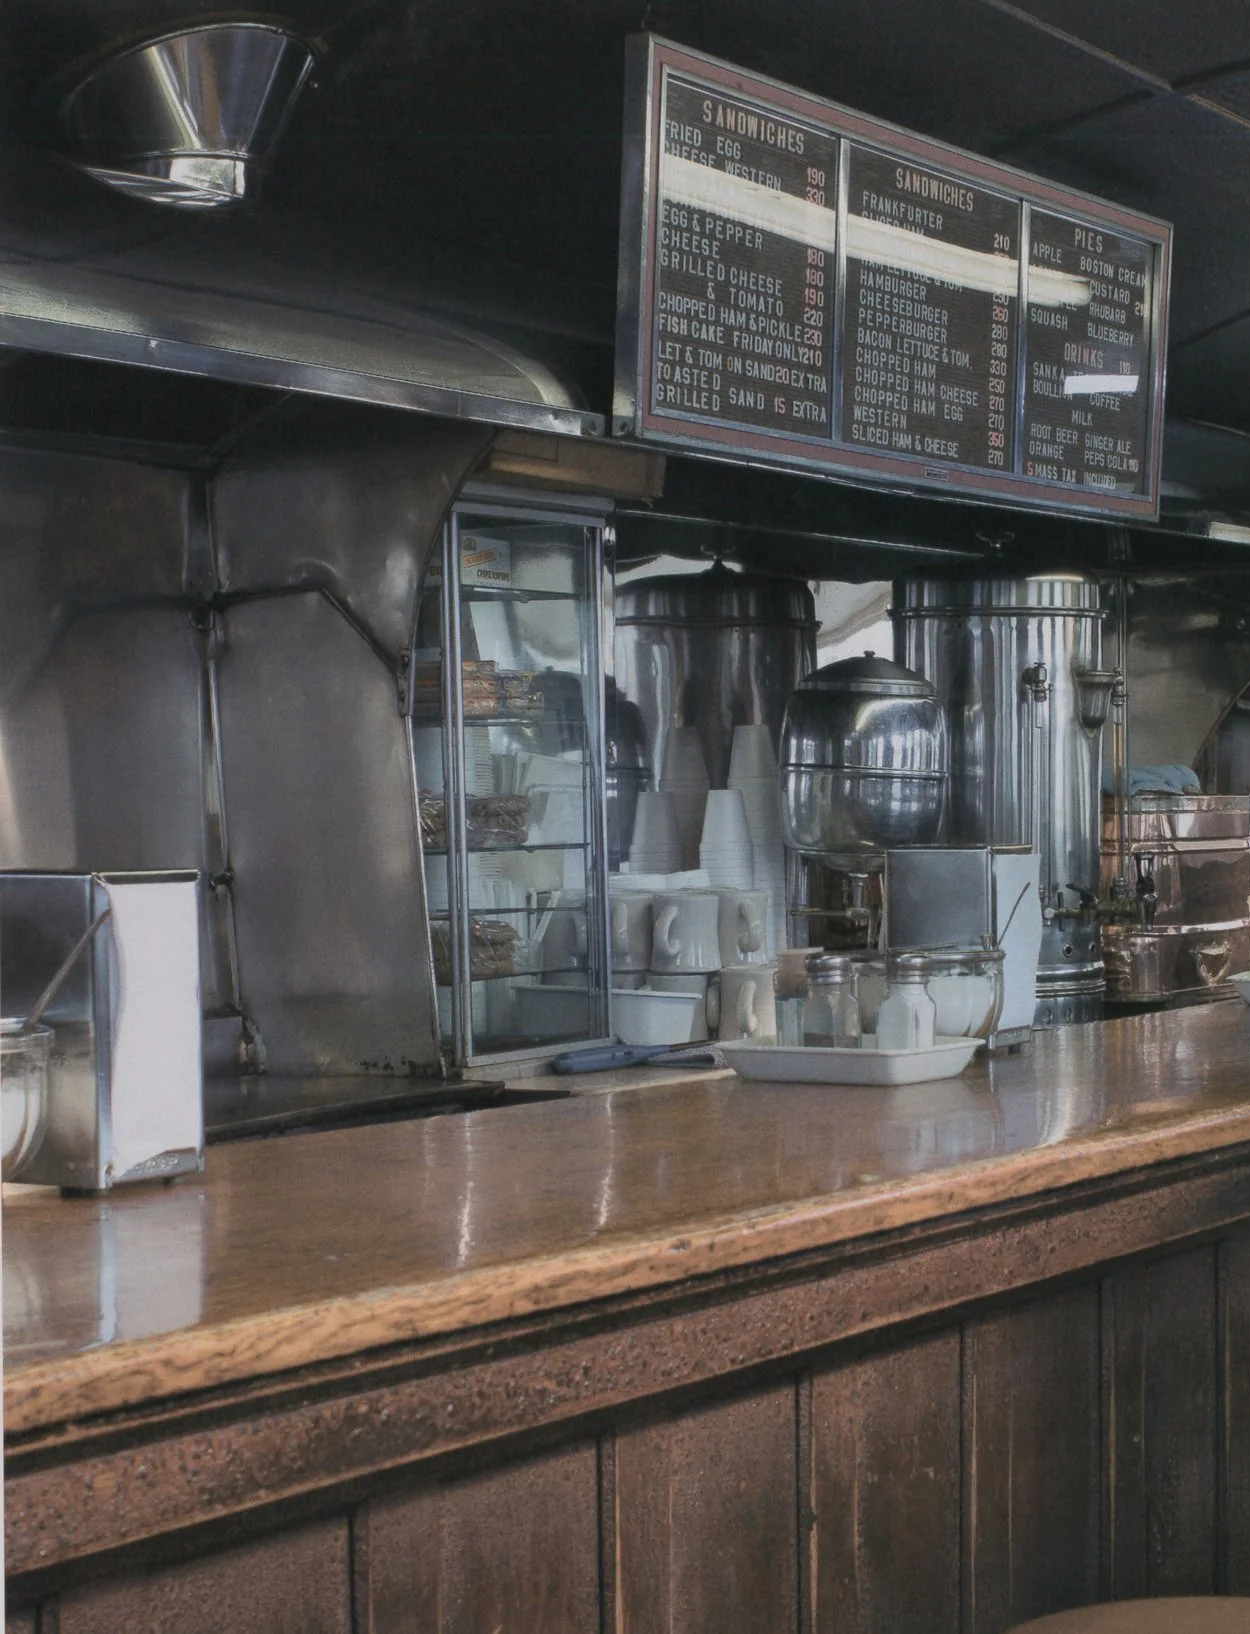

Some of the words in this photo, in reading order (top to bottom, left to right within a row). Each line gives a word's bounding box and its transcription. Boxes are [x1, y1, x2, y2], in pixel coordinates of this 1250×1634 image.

[702, 100, 805, 155] SANDWICHES
[664, 119, 702, 147] FRIED
[716, 136, 741, 160] EGG
[806, 167, 825, 187] 190
[725, 159, 781, 191] WESTERN
[895, 168, 974, 212] SANDWICHES
[662, 205, 688, 230] EGG
[692, 215, 701, 233] &
[705, 217, 763, 249] PEPPER
[806, 247, 825, 267] 180
[862, 191, 943, 231] FRANKFURTER
[993, 233, 1010, 250] 210
[661, 227, 721, 259] CHEESE
[805, 268, 824, 287] 180
[1033, 242, 1062, 264] APPLE
[1074, 228, 1103, 254] PIES
[660, 249, 725, 281] GRILLED
[729, 267, 783, 297] CHEESE
[804, 288, 824, 307] 190
[860, 268, 927, 301] HAMBURGER
[1080, 256, 1114, 279] BOSTON
[1118, 268, 1148, 289] CREAM
[706, 282, 715, 300] &
[729, 287, 784, 317] TOMATO
[803, 308, 823, 327] 220
[859, 289, 948, 326] CHEESEBURGER
[1089, 280, 1131, 304] CUSTARD
[658, 291, 716, 321] CHOPPED
[720, 307, 746, 330] HAM
[803, 328, 823, 347] 230
[858, 308, 947, 344] PEPPERBURGER
[1031, 308, 1068, 330] SQUASH
[1089, 302, 1127, 325] RHUBARB
[659, 314, 688, 336] FISH
[691, 321, 725, 345] CAKE
[733, 330, 774, 357] FRIDAY
[775, 341, 804, 362] ONLY
[802, 348, 822, 367] 210
[857, 327, 892, 350] BACON
[896, 337, 940, 363] LETTUCE
[942, 348, 949, 364] &
[1087, 323, 1135, 348] BLUEBERRY
[658, 340, 682, 361] LET
[685, 346, 693, 364] &
[698, 348, 723, 370] TOM
[727, 356, 742, 374] ON
[745, 359, 775, 381] SAND
[775, 366, 789, 384] 20
[856, 347, 910, 374] CHOPPED
[914, 360, 936, 379] HAM
[988, 377, 1006, 394] 250
[1033, 362, 1065, 381] SANKA
[1064, 343, 1104, 369] DRINKS
[656, 383, 720, 412] GRILLED
[729, 387, 765, 410] SAND
[774, 397, 786, 414] 15
[792, 401, 827, 423] EXTRA
[855, 366, 909, 392] CHOPPED
[914, 379, 936, 398] HAM
[940, 384, 979, 407] CHEESE
[989, 395, 1005, 412] 270
[1089, 392, 1121, 411] COFFEE
[853, 404, 907, 429] WESTERN
[854, 385, 908, 411] CHOPPED
[913, 399, 936, 417] HAM
[944, 404, 964, 422] EGG
[988, 413, 1005, 431] 270
[1071, 409, 1093, 426] MILK
[852, 424, 889, 445] SLICED
[892, 431, 912, 450] HAM
[915, 435, 922, 451] &
[924, 437, 959, 458] CHEESE
[988, 449, 1004, 466] 270
[1029, 441, 1064, 460] ORANGE
[1031, 423, 1052, 439] ROOT
[1056, 427, 1078, 445] BEER
[1085, 433, 1114, 452] GINGER
[1117, 440, 1131, 455] ALE
[1035, 463, 1058, 480] MASS
[1062, 467, 1077, 484] TAX
[1083, 471, 1116, 489] INCLUDED
[1107, 455, 1128, 471] COLA
